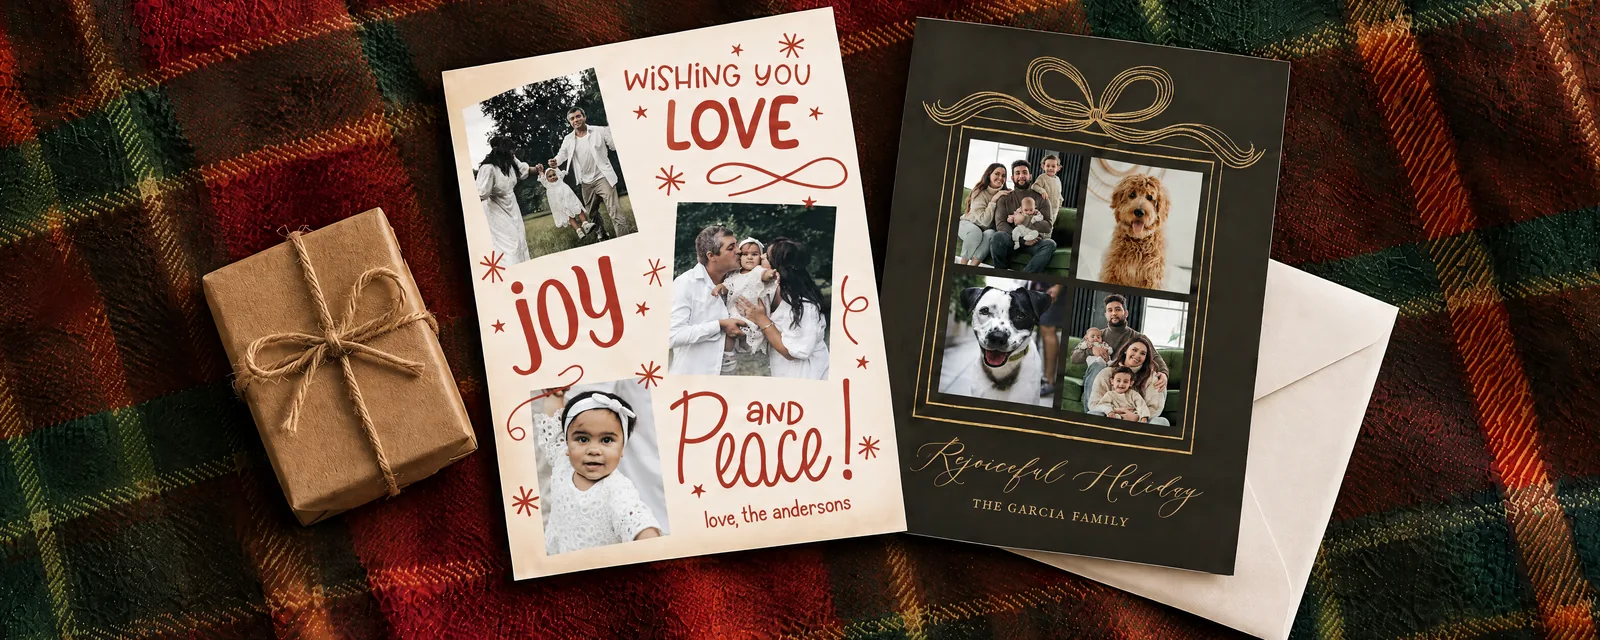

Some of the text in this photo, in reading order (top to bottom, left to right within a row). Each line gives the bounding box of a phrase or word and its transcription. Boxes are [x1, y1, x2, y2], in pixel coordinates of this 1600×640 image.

[666, 95, 800, 151] LOVE
[510, 255, 625, 376] joy
[910, 436, 1204, 519] Rejoiceful Holiday
[704, 498, 852, 529] love, the andersons
[972, 498, 1130, 528] THE GARCIA FAMILY
